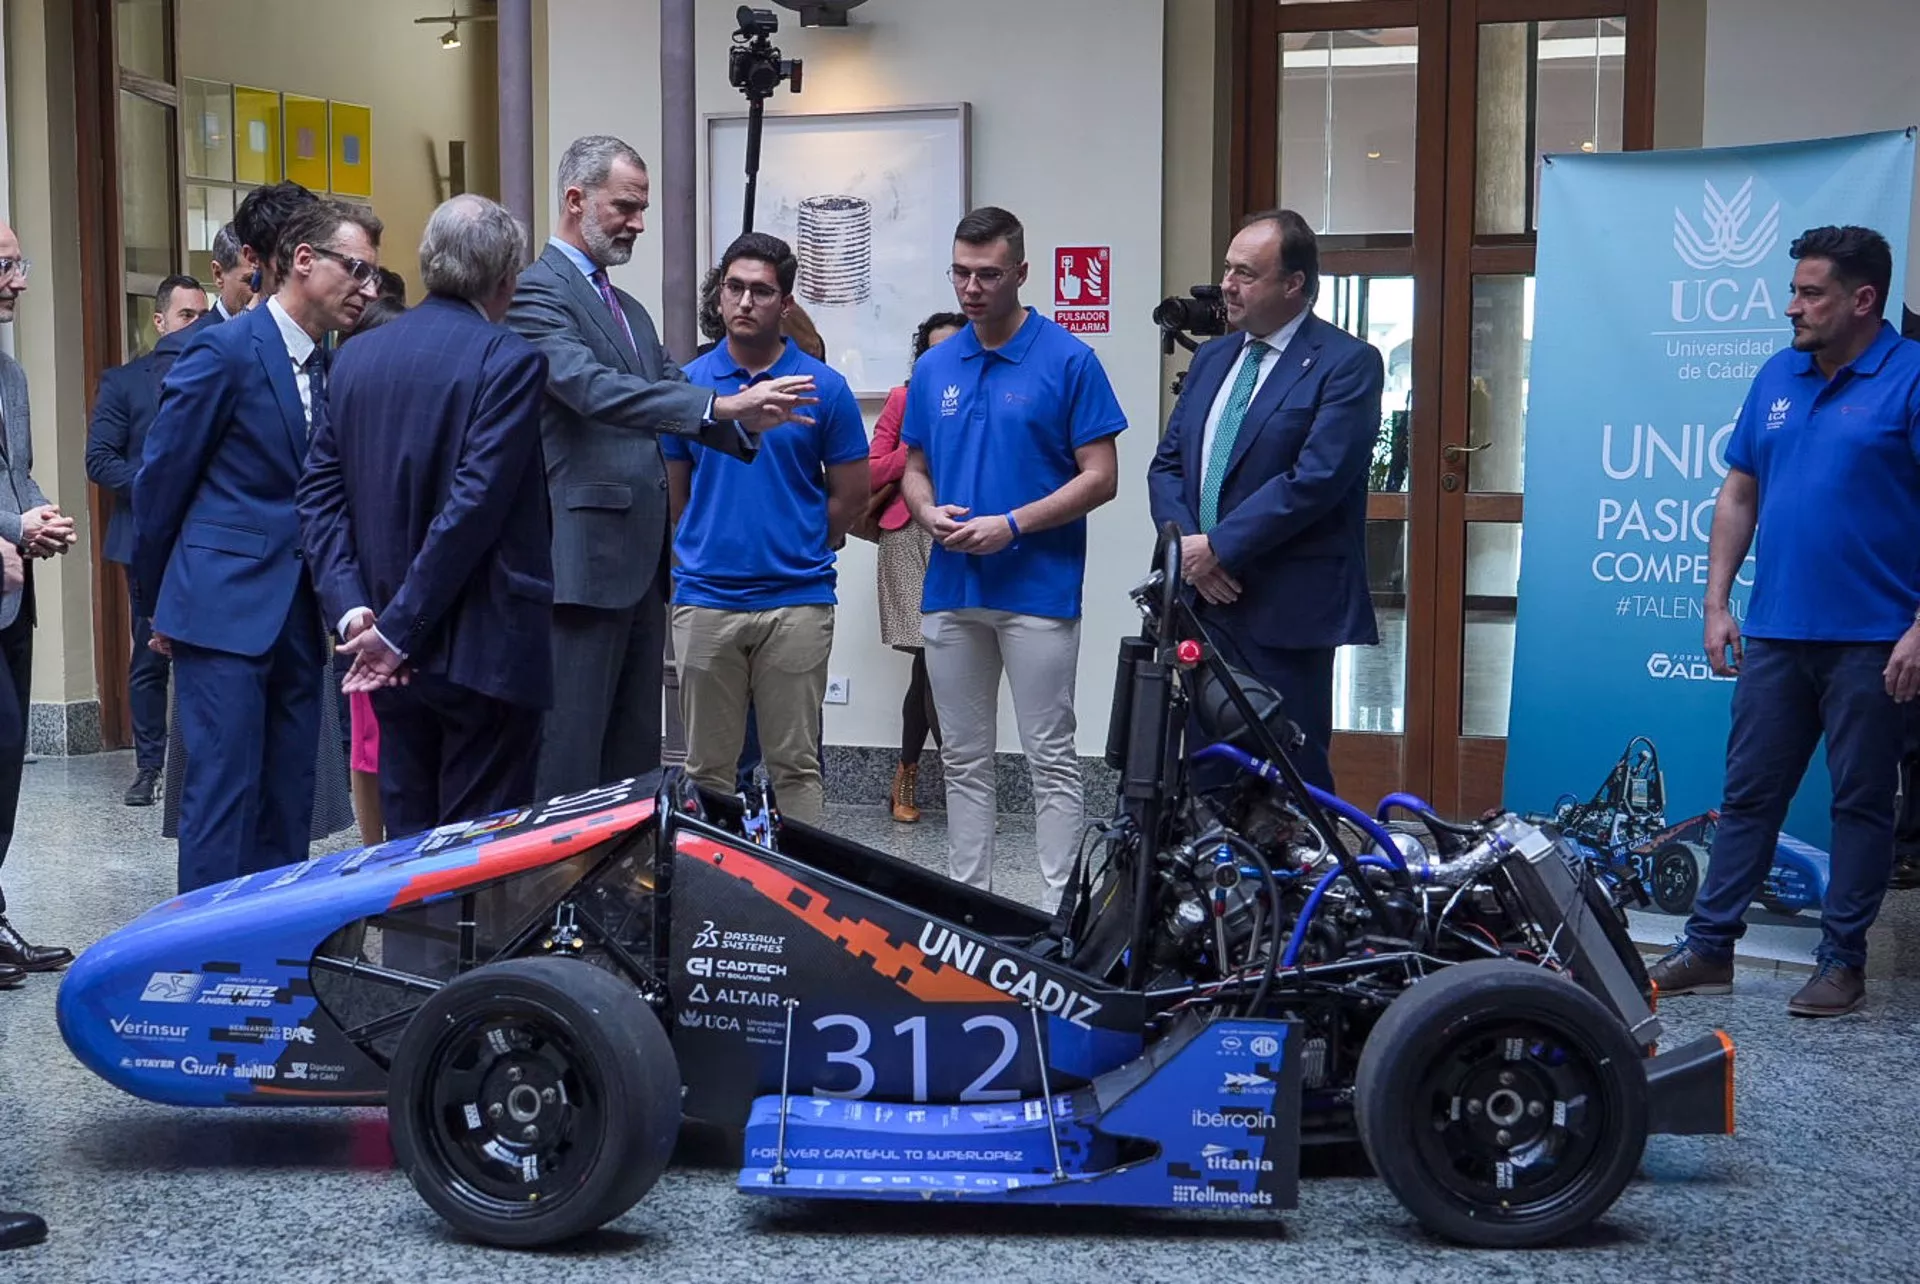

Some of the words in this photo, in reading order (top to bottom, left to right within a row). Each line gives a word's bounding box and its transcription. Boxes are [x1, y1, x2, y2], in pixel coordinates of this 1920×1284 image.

[1669, 278, 1776, 322] UCA
[1057, 311, 1106, 321] PULSADOR
[1070, 322, 1107, 331] ALARMA
[1666, 338, 1774, 357] Universidad
[1679, 363, 1701, 379] de
[1707, 361, 1760, 379] Cádiz
[723, 931, 785, 944] DASSAULT
[716, 959, 787, 976] CADTECH
[919, 921, 986, 976] UNI
[989, 957, 1102, 1031] CADIZ
[202, 983, 279, 998] JEREZ
[716, 988, 779, 1007] ALTAIR
[110, 1014, 190, 1036] Verinsur
[705, 1014, 740, 1031] UCA
[135, 1058, 175, 1069] STAYER
[181, 1056, 228, 1077] Gurit
[812, 1014, 1021, 1102] 312
[1191, 1109, 1276, 1128] ibercoin
[823, 1148, 900, 1160] GRATEFUL
[903, 1149, 923, 1160] TO
[926, 1150, 1023, 1161] SUPERLOPEZ
[1206, 1156, 1273, 1171] titania
